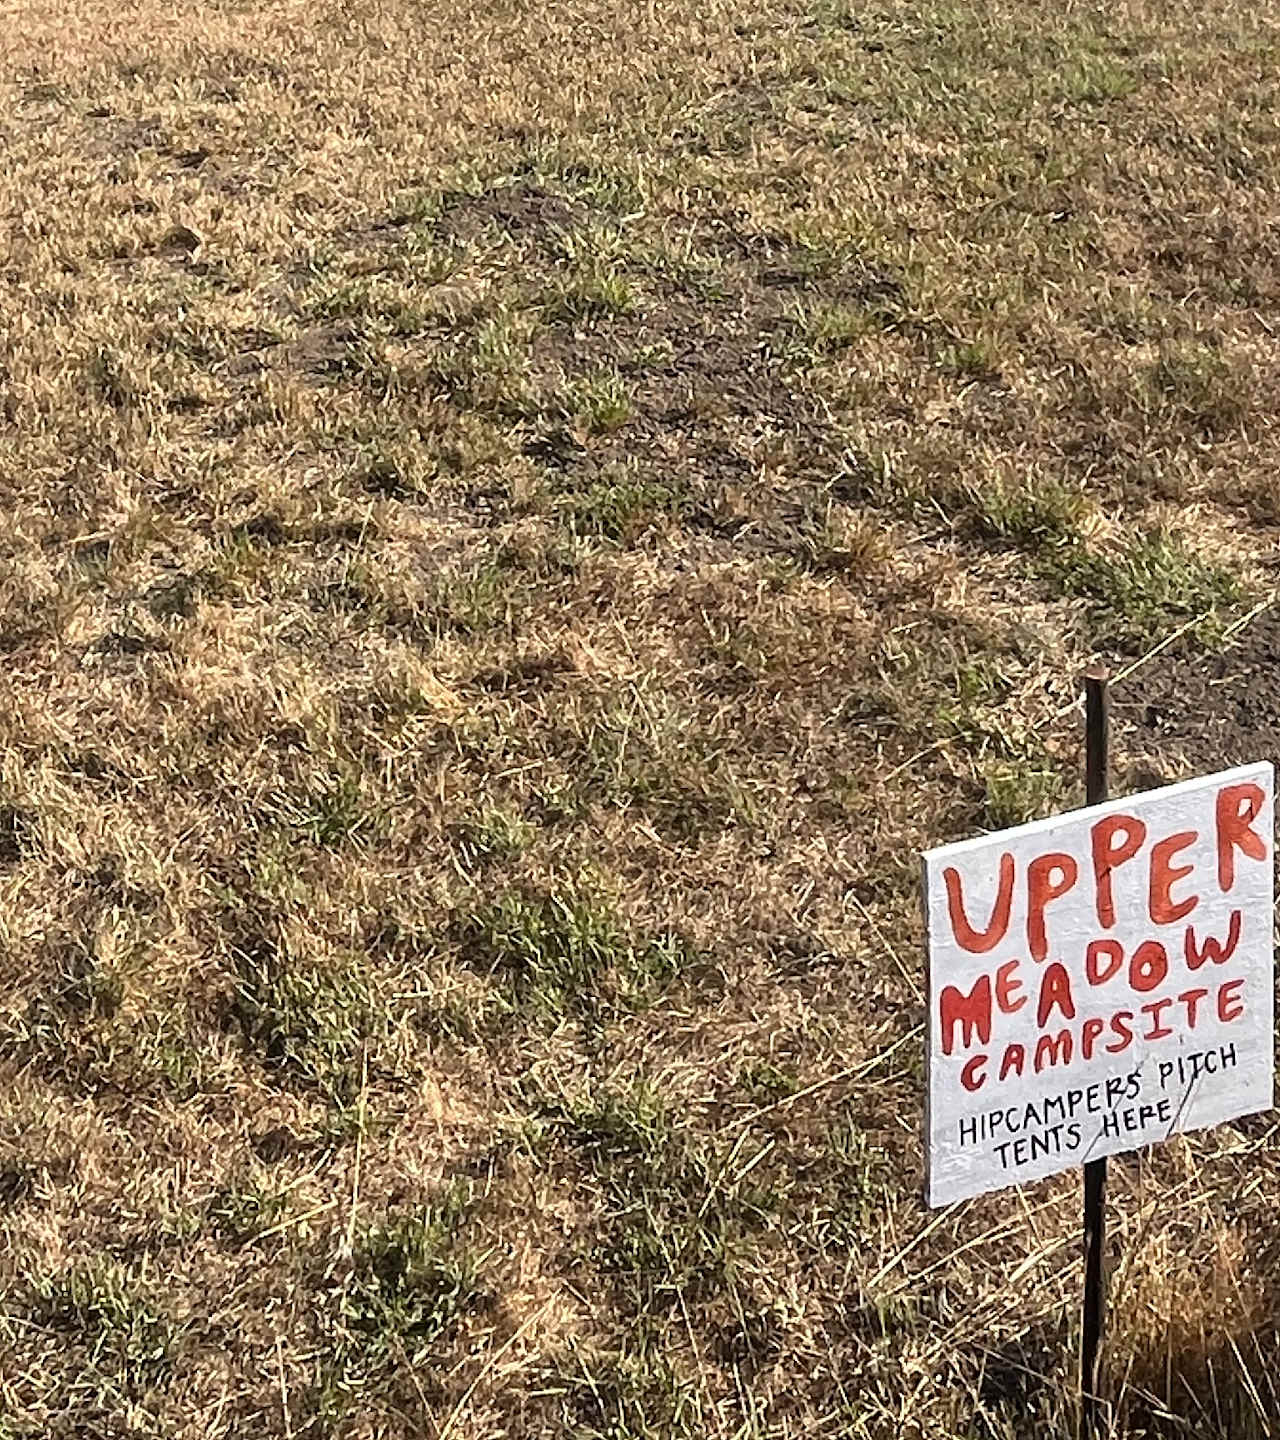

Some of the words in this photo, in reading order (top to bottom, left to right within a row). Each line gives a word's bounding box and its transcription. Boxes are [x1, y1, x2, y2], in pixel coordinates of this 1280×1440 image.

[943, 782, 1268, 962] UPPER
[940, 910, 1241, 1055] MEADOW
[960, 979, 1245, 1091] CAMPSITE
[959, 1073, 1141, 1146] HIPCAMPERS
[1159, 1043, 1237, 1087] PITCH
[994, 1124, 1081, 1168] TENTS
[1102, 1099, 1172, 1138] HERE
